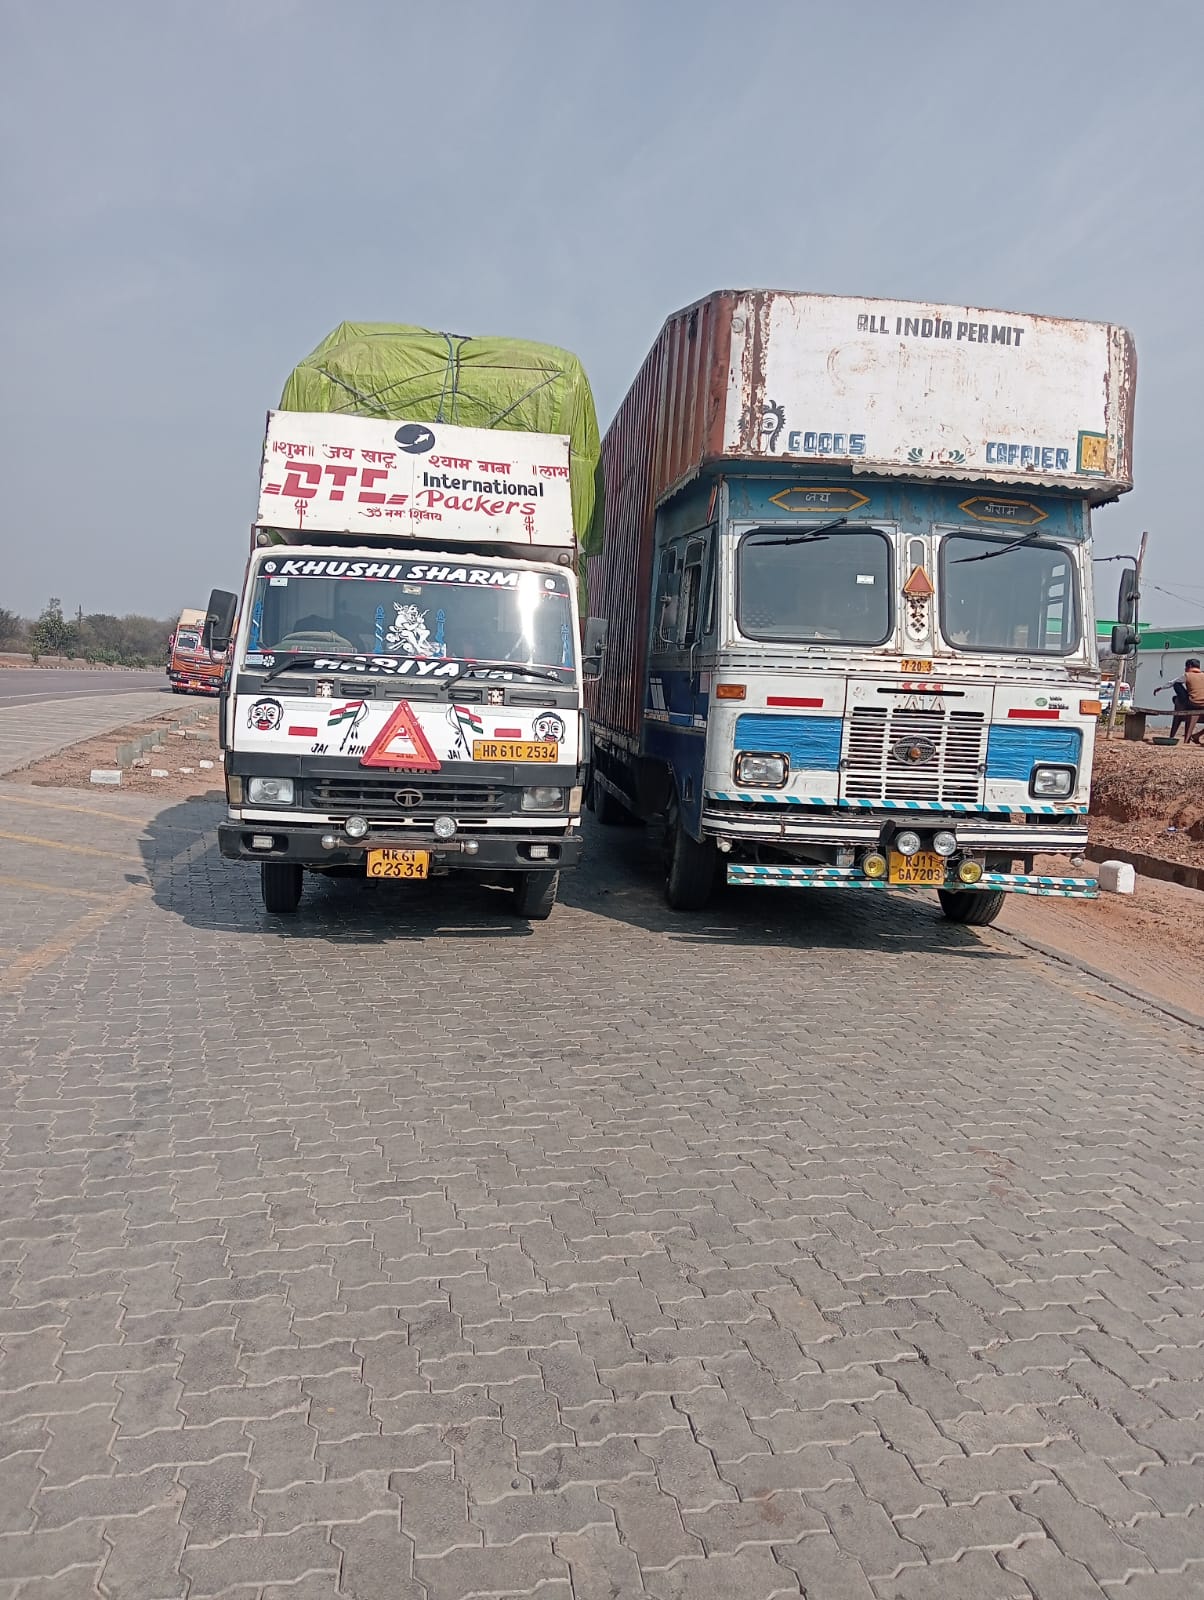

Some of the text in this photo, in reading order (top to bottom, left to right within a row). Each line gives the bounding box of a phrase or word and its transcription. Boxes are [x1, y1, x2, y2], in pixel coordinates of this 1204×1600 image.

[857, 314, 1025, 347] ALL INDIA PERMIT
[281, 460, 389, 505] DTC
[423, 471, 544, 497] International
[415, 489, 537, 517] Packers
[280, 560, 402, 579] KHUSHI
[310, 743, 329, 755] JAI
[447, 749, 461, 760] JAI
[482, 744, 498, 758] HR
[500, 745, 523, 758] 61C
[527, 745, 556, 759] 2534
[371, 862, 424, 877] C2534
[898, 868, 941, 881] GA7203
